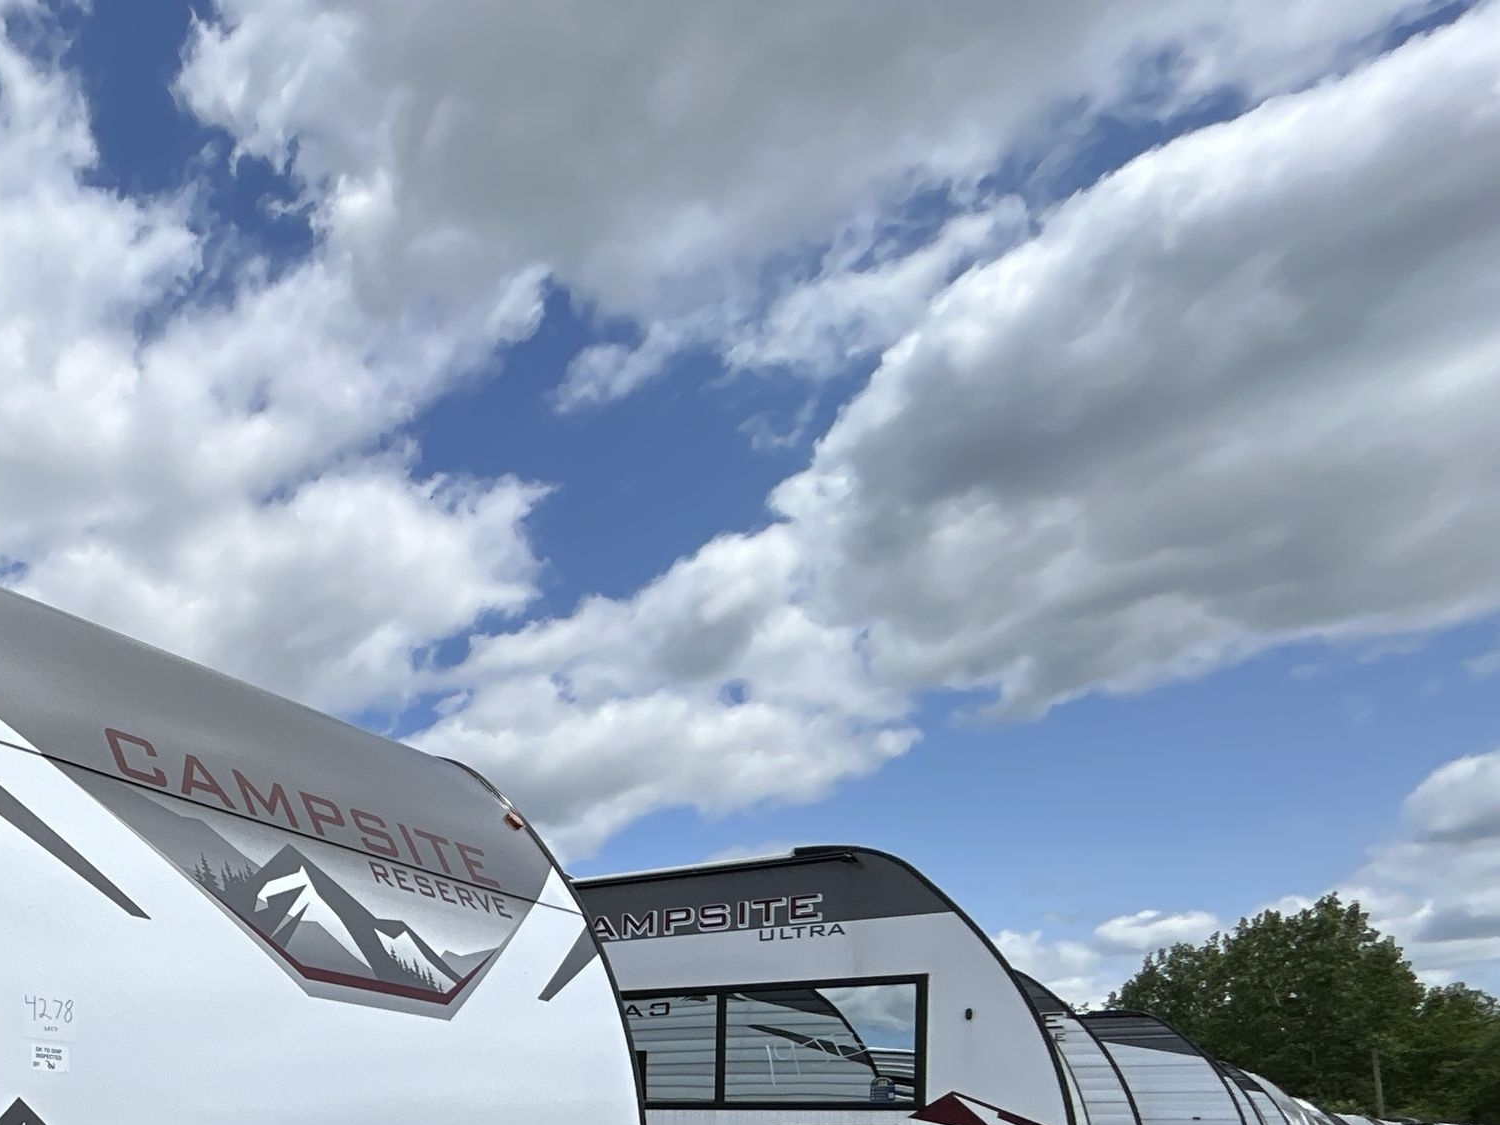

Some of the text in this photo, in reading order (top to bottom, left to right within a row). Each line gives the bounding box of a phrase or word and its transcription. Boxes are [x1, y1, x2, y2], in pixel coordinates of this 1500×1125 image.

[104, 727, 501, 888] CAMPSITE
[368, 861, 512, 919] RESERVE
[759, 922, 846, 942] ULTRA
[24, 994, 74, 1024] 4278
